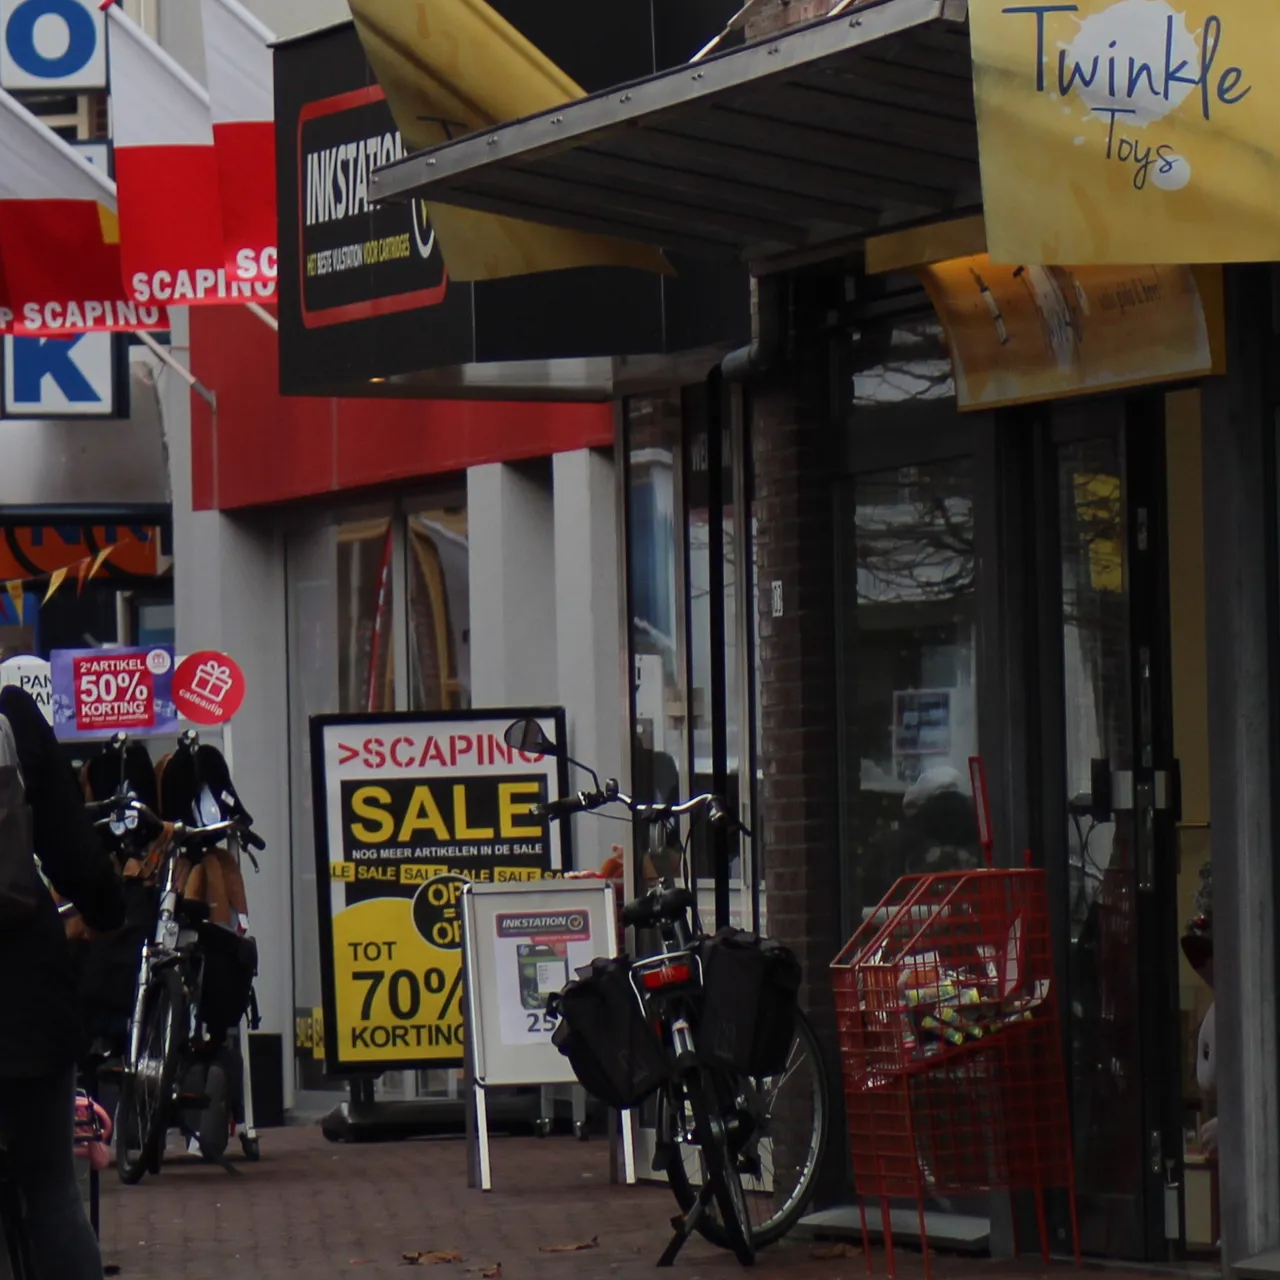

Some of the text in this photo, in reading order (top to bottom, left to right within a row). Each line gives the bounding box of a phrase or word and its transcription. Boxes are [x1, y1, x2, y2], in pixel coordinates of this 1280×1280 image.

[1001, 4, 1252, 120] Twinkle
[1091, 107, 1180, 190] Toys
[317, 249, 332, 275] BESTE
[332, 243, 363, 272] VULSTATION
[363, 239, 379, 265] VOOR
[379, 232, 410, 263] CARTRIDGES
[23, 301, 160, 330] SCAPINO
[90, 659, 145, 673] ARTIKEL
[80, 671, 148, 702] 50%
[179, 688, 224, 717] cadeautip
[350, 782, 543, 844] SALE
[352, 844, 543, 860] NOG MEER ARTIKELEN IN DE SALE
[358, 866, 397, 880] SALE
[502, 916, 566, 928] INKSTATION
[348, 941, 397, 962] TOT
[351, 967, 464, 1021] 70%
